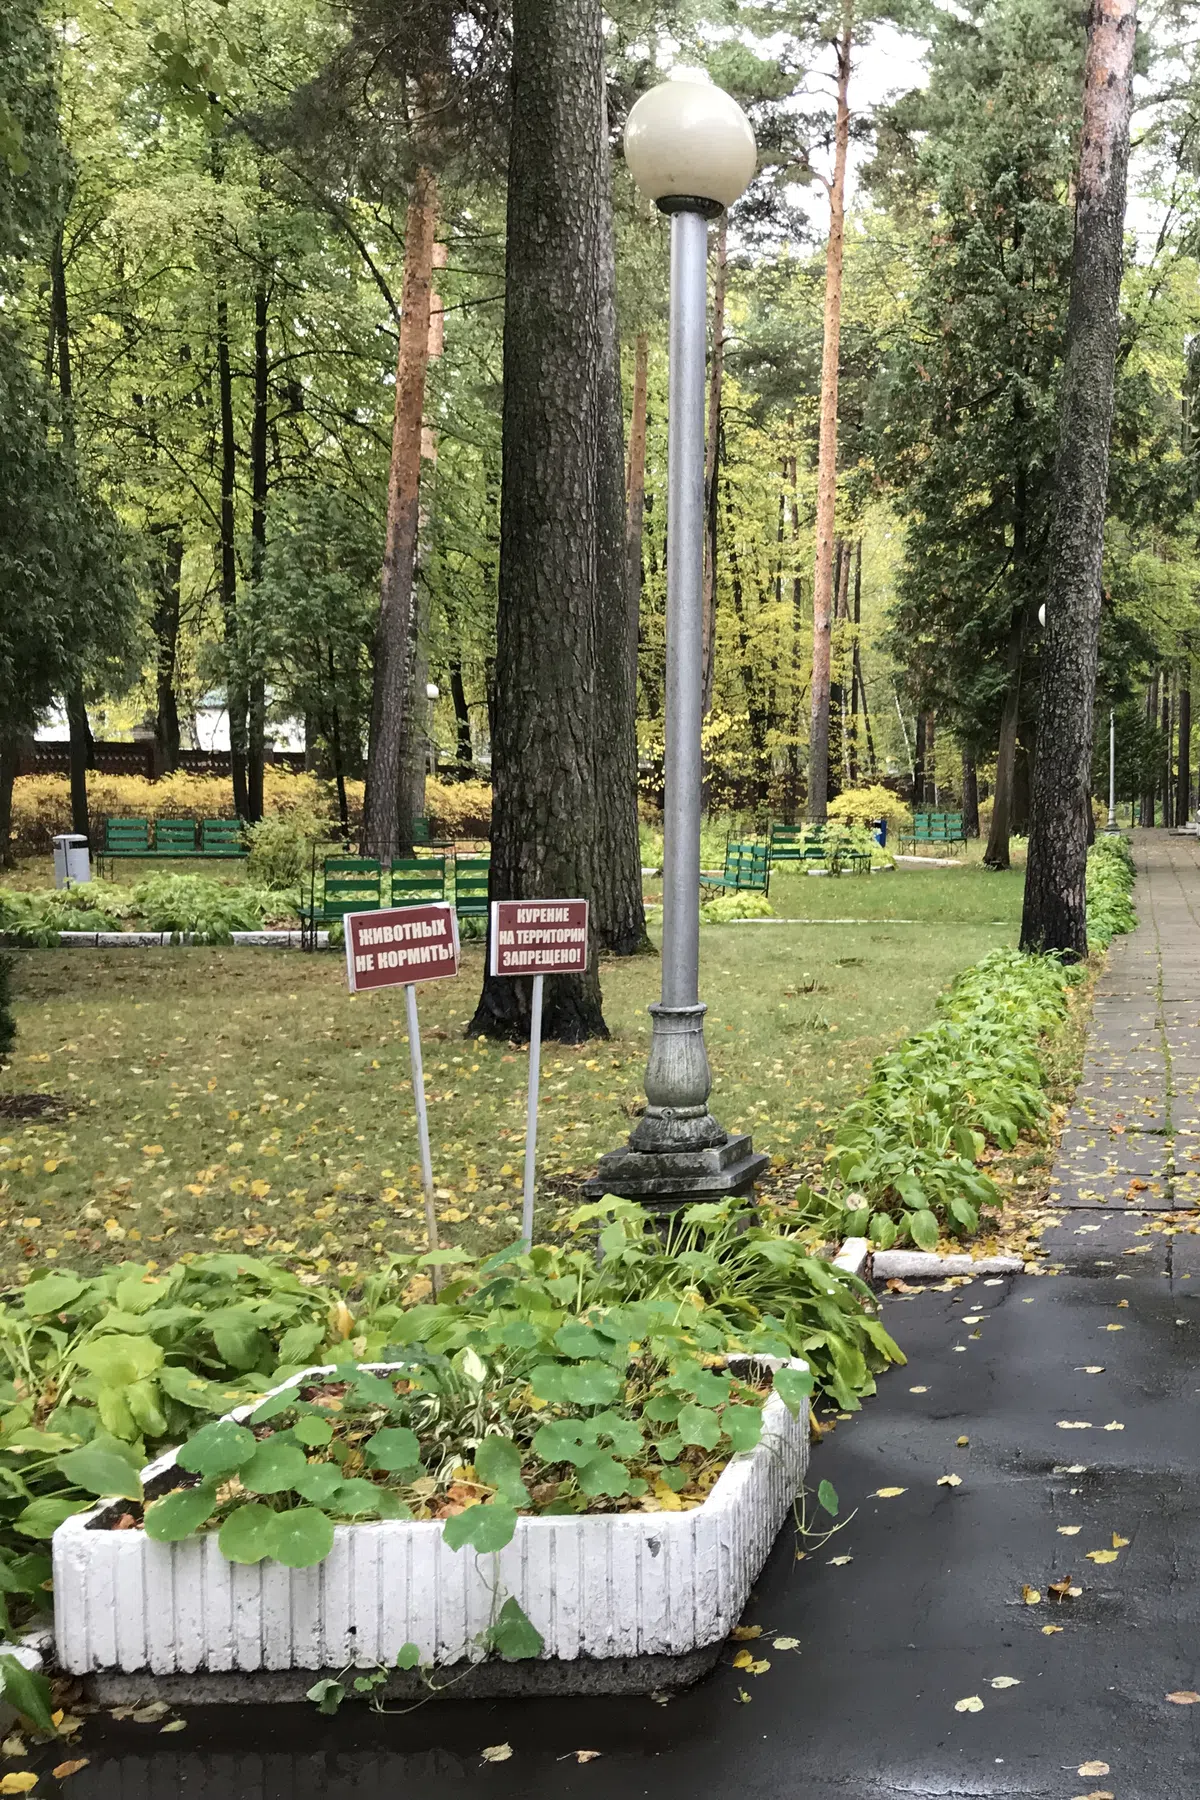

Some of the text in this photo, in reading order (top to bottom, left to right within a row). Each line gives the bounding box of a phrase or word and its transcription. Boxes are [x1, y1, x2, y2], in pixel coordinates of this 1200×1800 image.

[516, 907, 570, 924] КУРЕНИЕ
[358, 919, 447, 946] ЖИВОТНЫХ
[499, 928, 585, 945] НА ТЕРРИТОРИИ
[355, 942, 455, 973] НЕ КОРМИТЬ!
[502, 948, 581, 967] ЗАПРЕЩЕНО!
